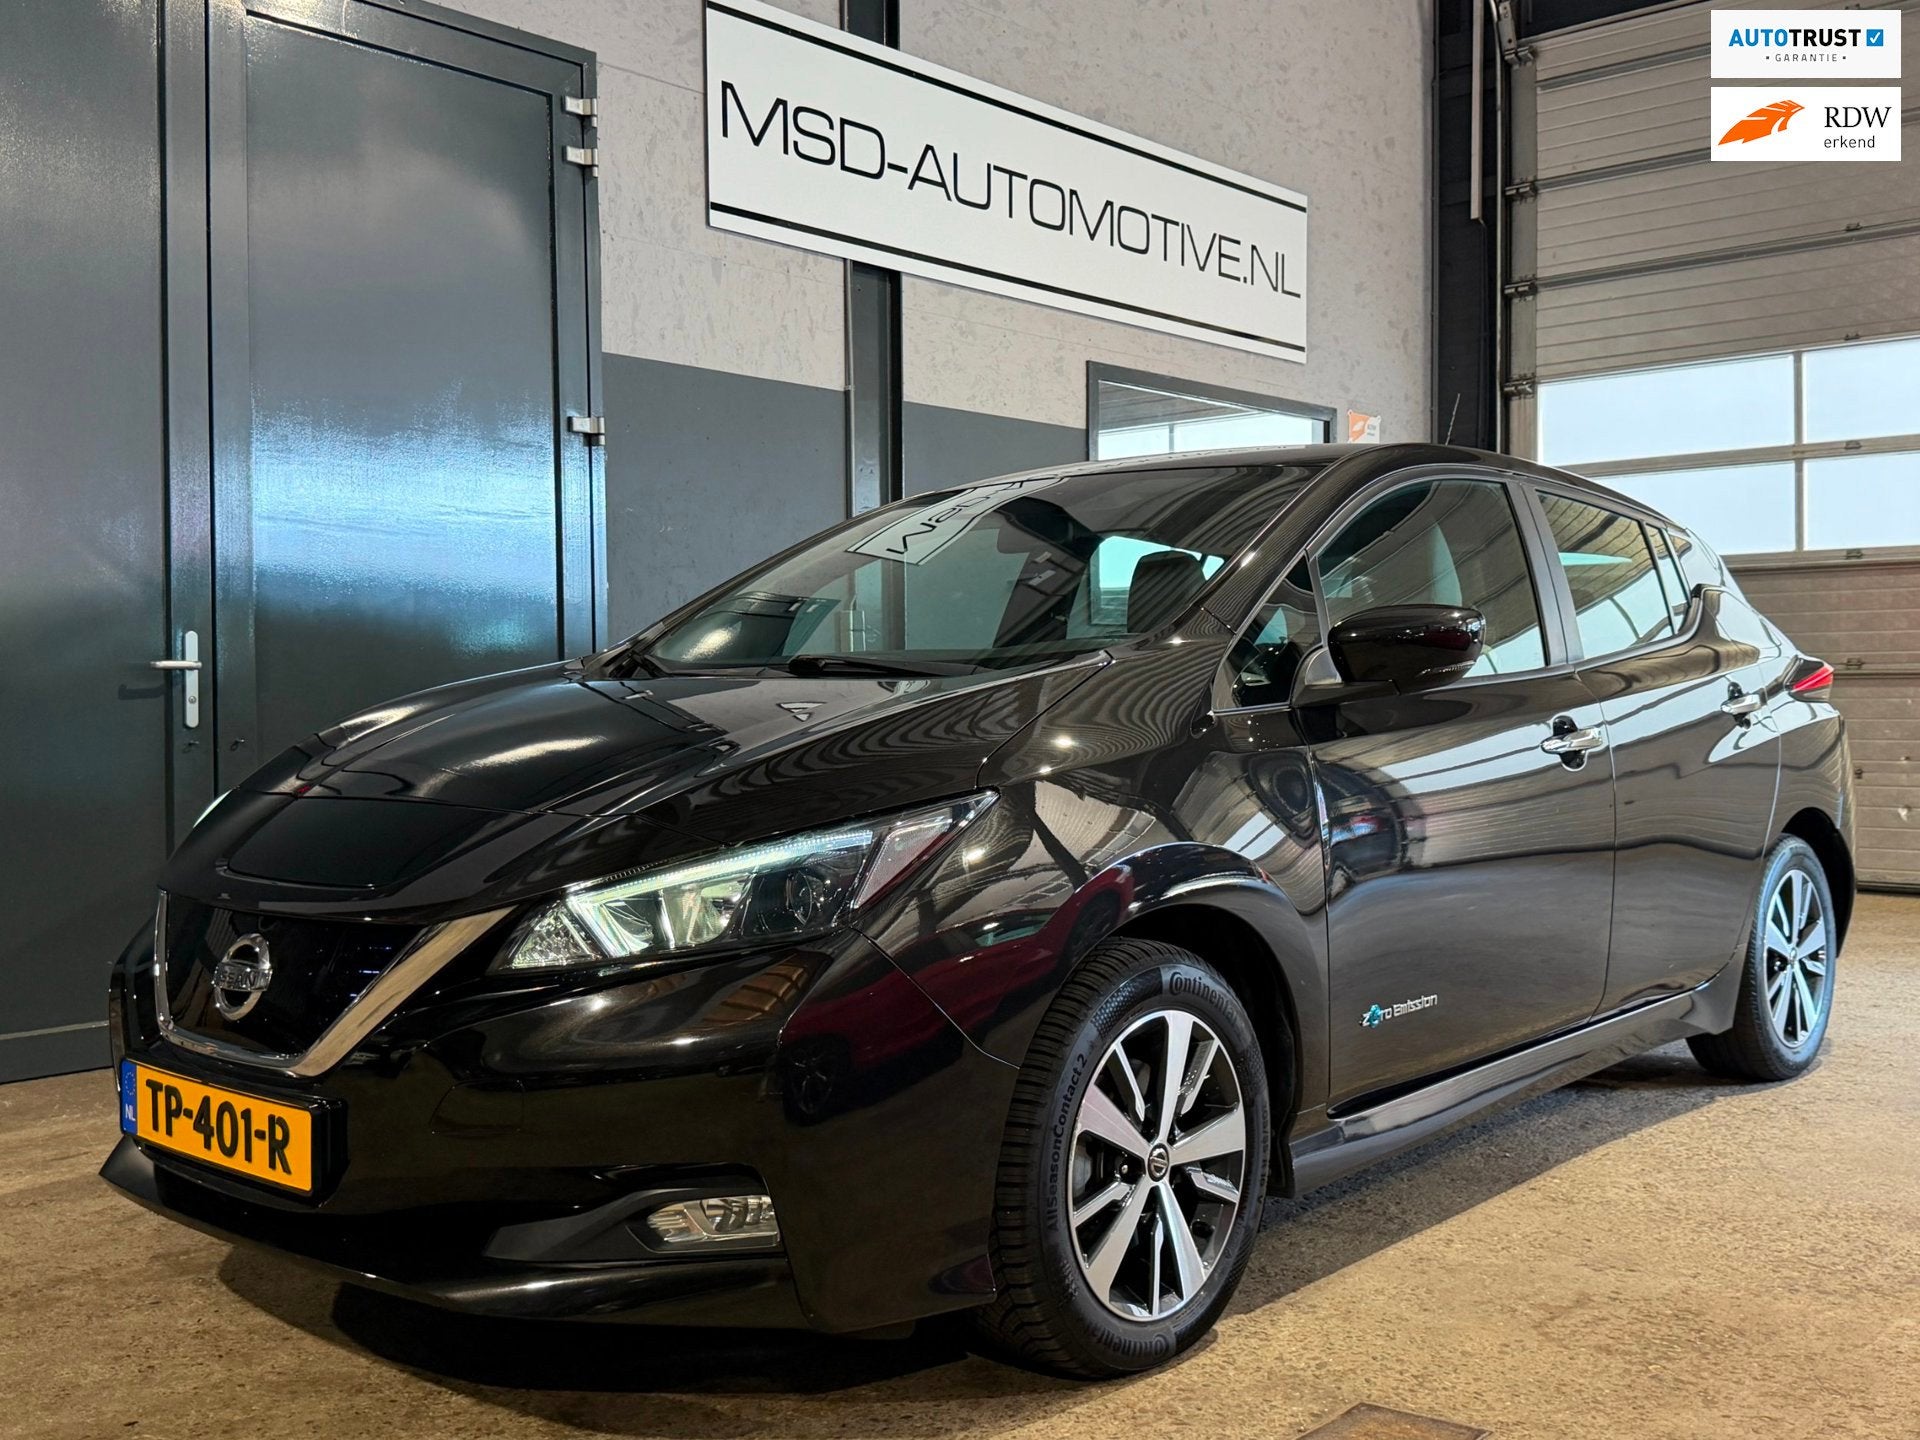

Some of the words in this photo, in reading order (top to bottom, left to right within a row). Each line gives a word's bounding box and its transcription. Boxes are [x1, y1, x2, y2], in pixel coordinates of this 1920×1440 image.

[720, 80, 1302, 299] MSD-AUTOMOTIVE.NL
[1169, 971, 1238, 1025] Continental
[1393, 994, 1438, 1017] Emission
[125, 1102, 137, 1122] NL
[146, 1078, 292, 1176] TP-401-R
[1047, 1066, 1083, 1232] AllSeasonContact
